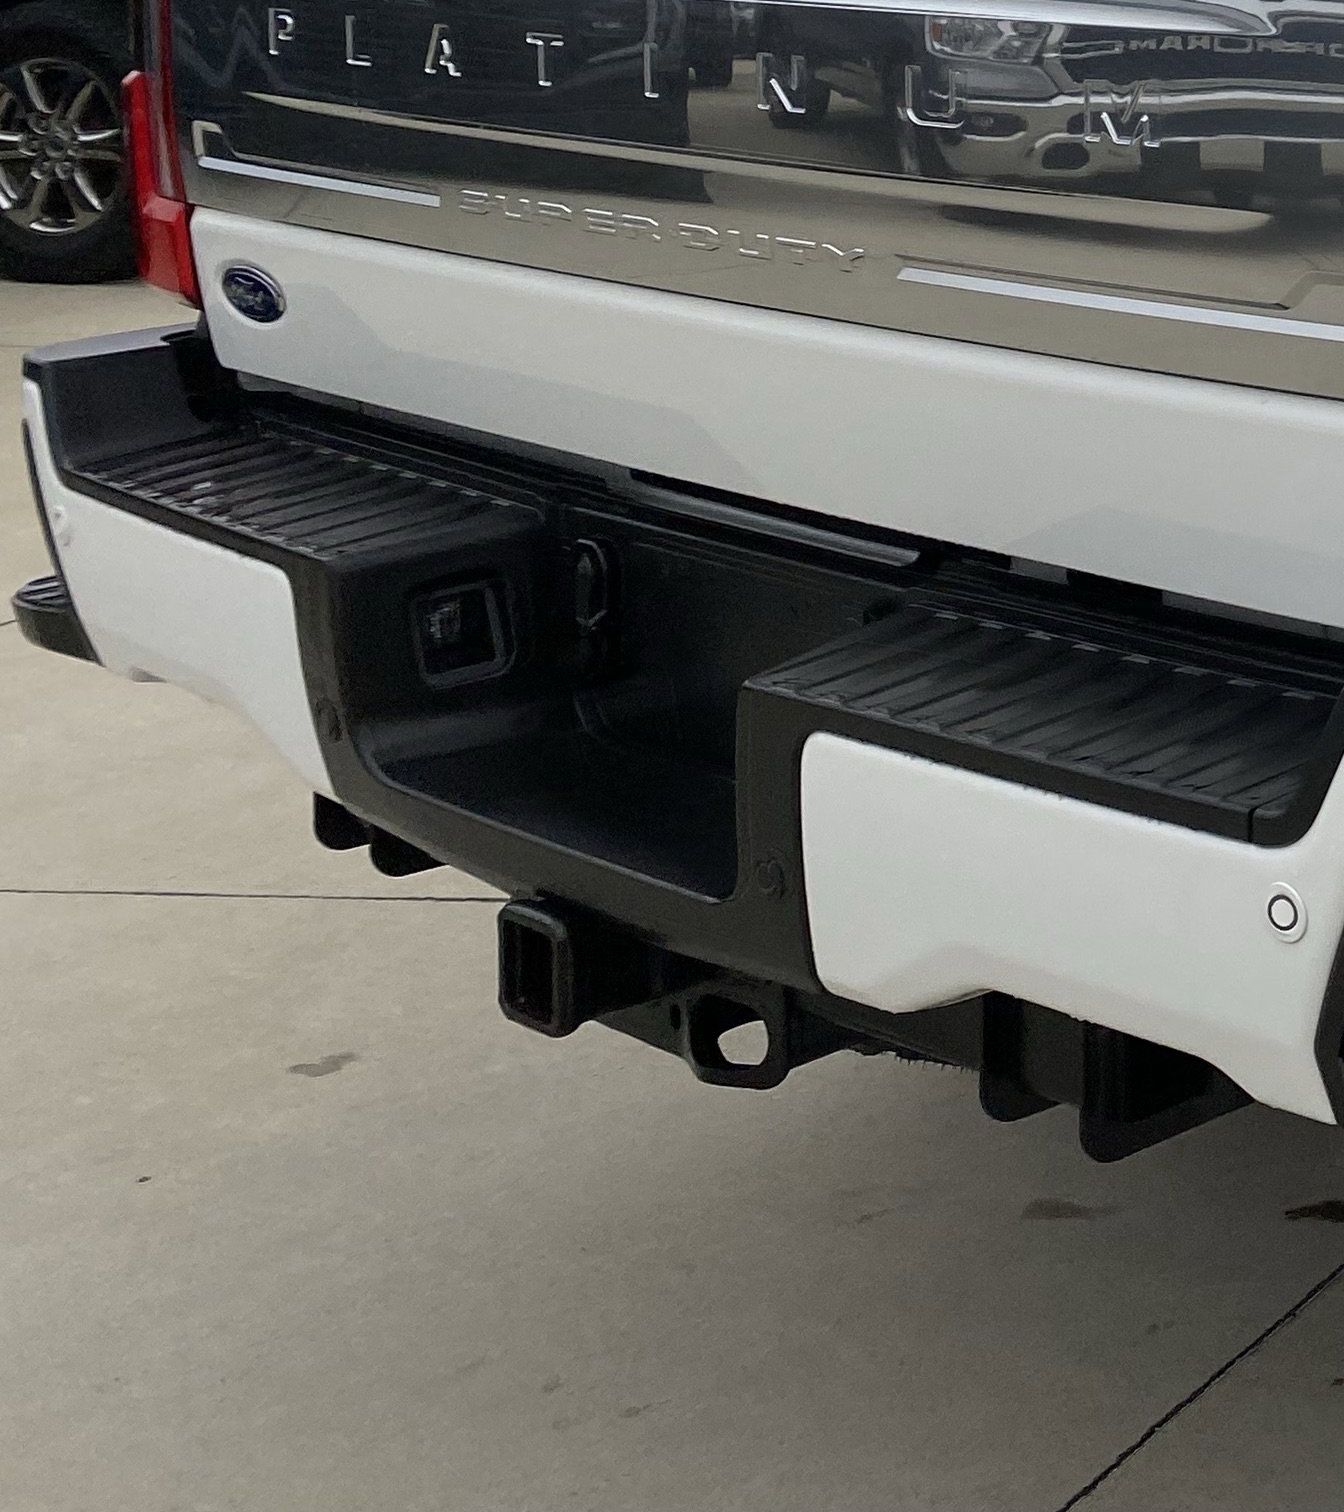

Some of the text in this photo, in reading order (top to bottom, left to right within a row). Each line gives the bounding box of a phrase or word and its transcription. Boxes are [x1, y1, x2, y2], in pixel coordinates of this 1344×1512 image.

[268, 7, 1161, 148] PLATINUM
[458, 189, 865, 273] SUPER DUTY
